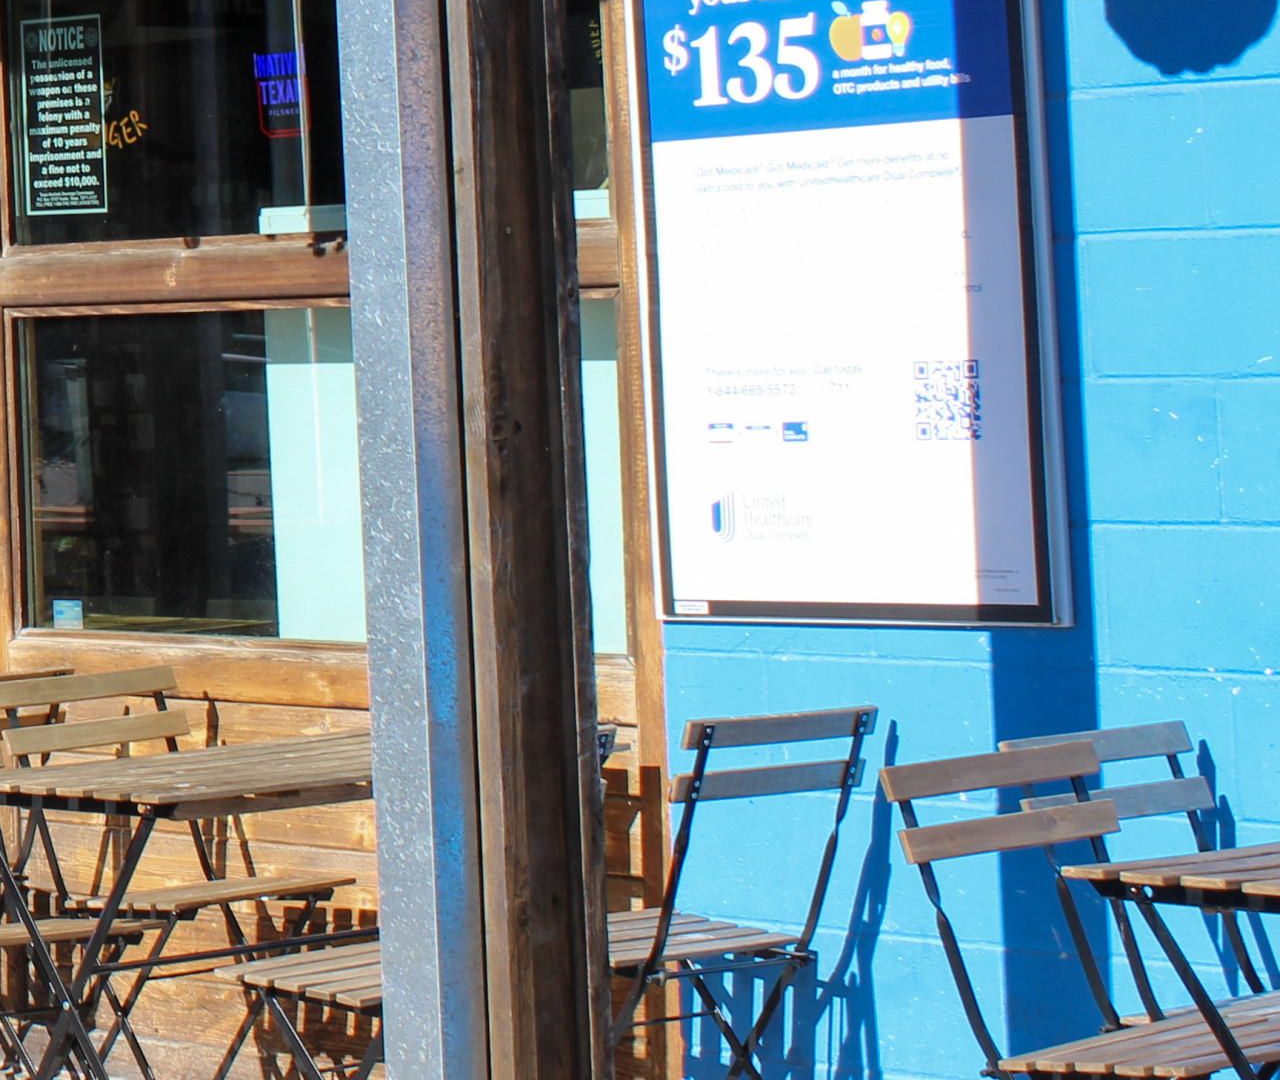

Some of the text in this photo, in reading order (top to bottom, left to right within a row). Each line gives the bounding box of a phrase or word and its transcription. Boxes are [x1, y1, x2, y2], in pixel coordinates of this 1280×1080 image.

[39, 26, 84, 52] NOTICE
[32, 57, 92, 69] The unlicensed
[663, 12, 820, 107] $135
[30, 70, 93, 84] possession of a
[832, 70, 839, 78] a
[840, 66, 872, 78] month
[873, 64, 888, 75] for
[889, 62, 924, 73] healthy
[29, 82, 97, 99] weapon on these
[833, 73, 971, 95] OTC products and utility bills
[37, 96, 90, 111] premises is a
[38, 110, 90, 123] felony with a
[29, 122, 101, 136] maximum penalty
[42, 138, 88, 150] of 10 years
[30, 149, 102, 163] imprisonment and
[41, 163, 91, 175] a fine not to
[34, 175, 100, 188] exceed $10,000.
[743, 494, 787, 511] United
[743, 510, 815, 528] Healthcare
